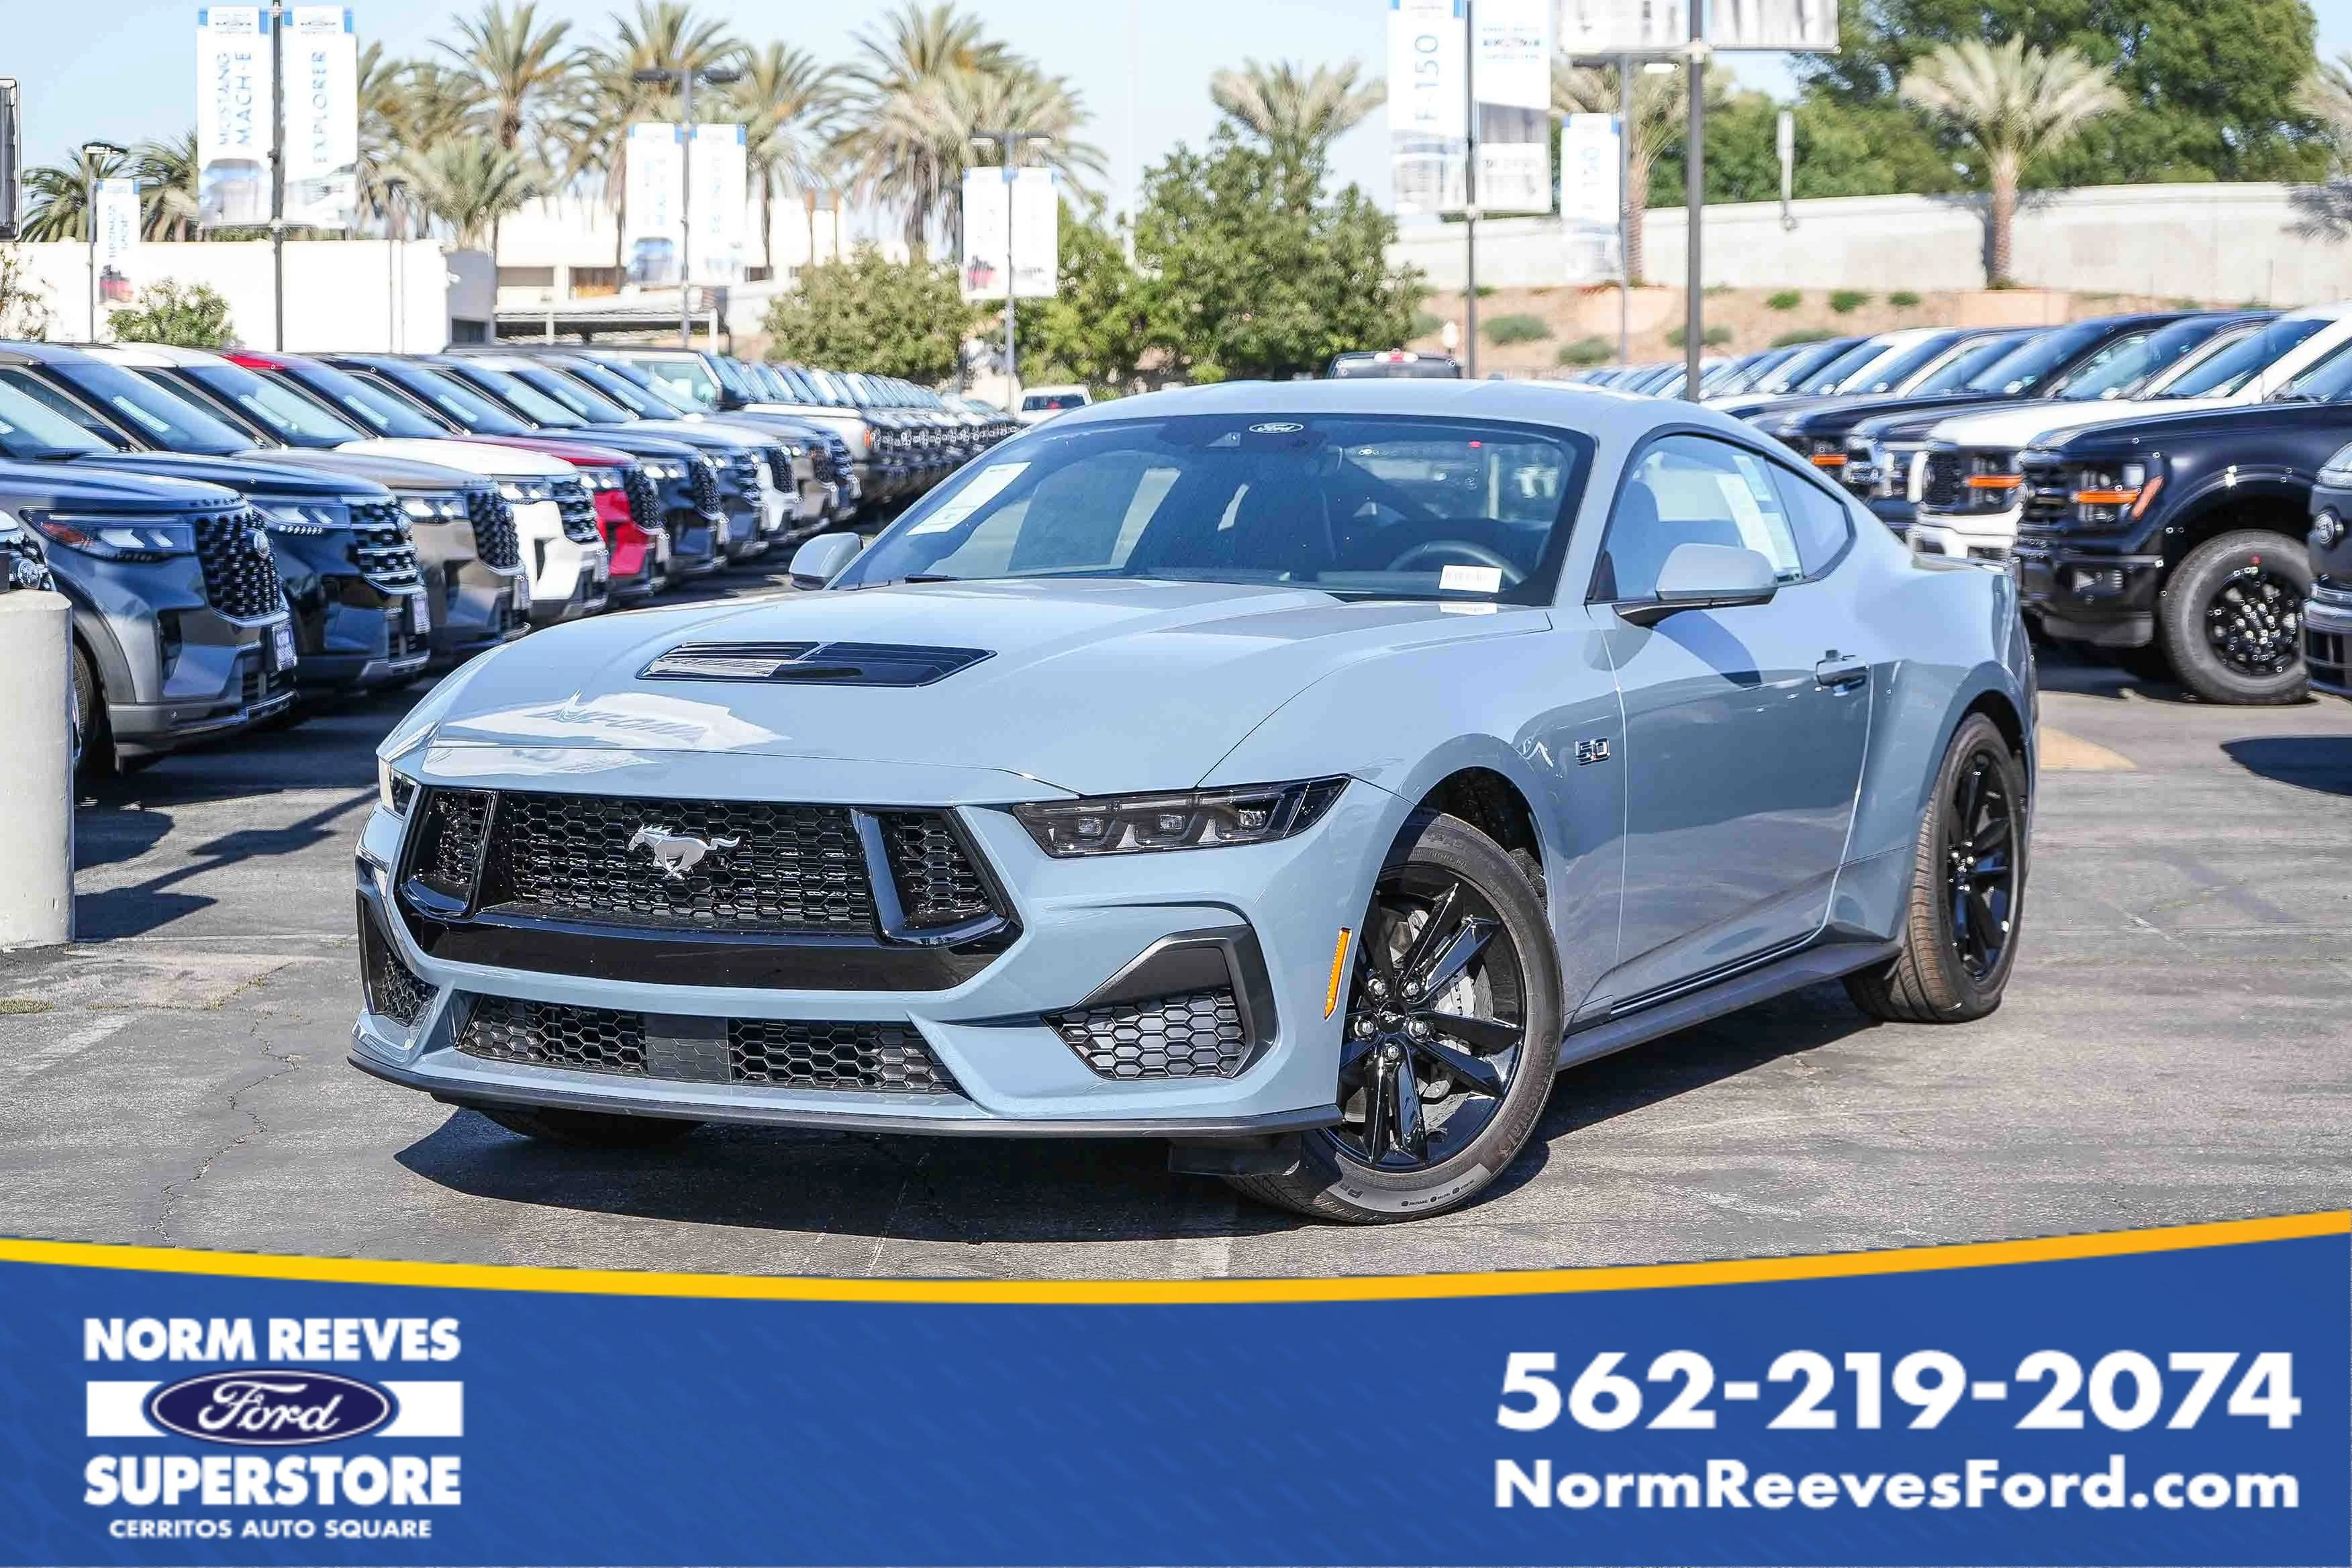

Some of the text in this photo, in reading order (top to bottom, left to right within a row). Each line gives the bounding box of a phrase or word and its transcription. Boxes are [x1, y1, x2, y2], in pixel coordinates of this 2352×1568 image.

[235, 51, 252, 146] MACH-E
[311, 51, 328, 163] EXPLORER
[1414, 34, 1439, 123] F-150
